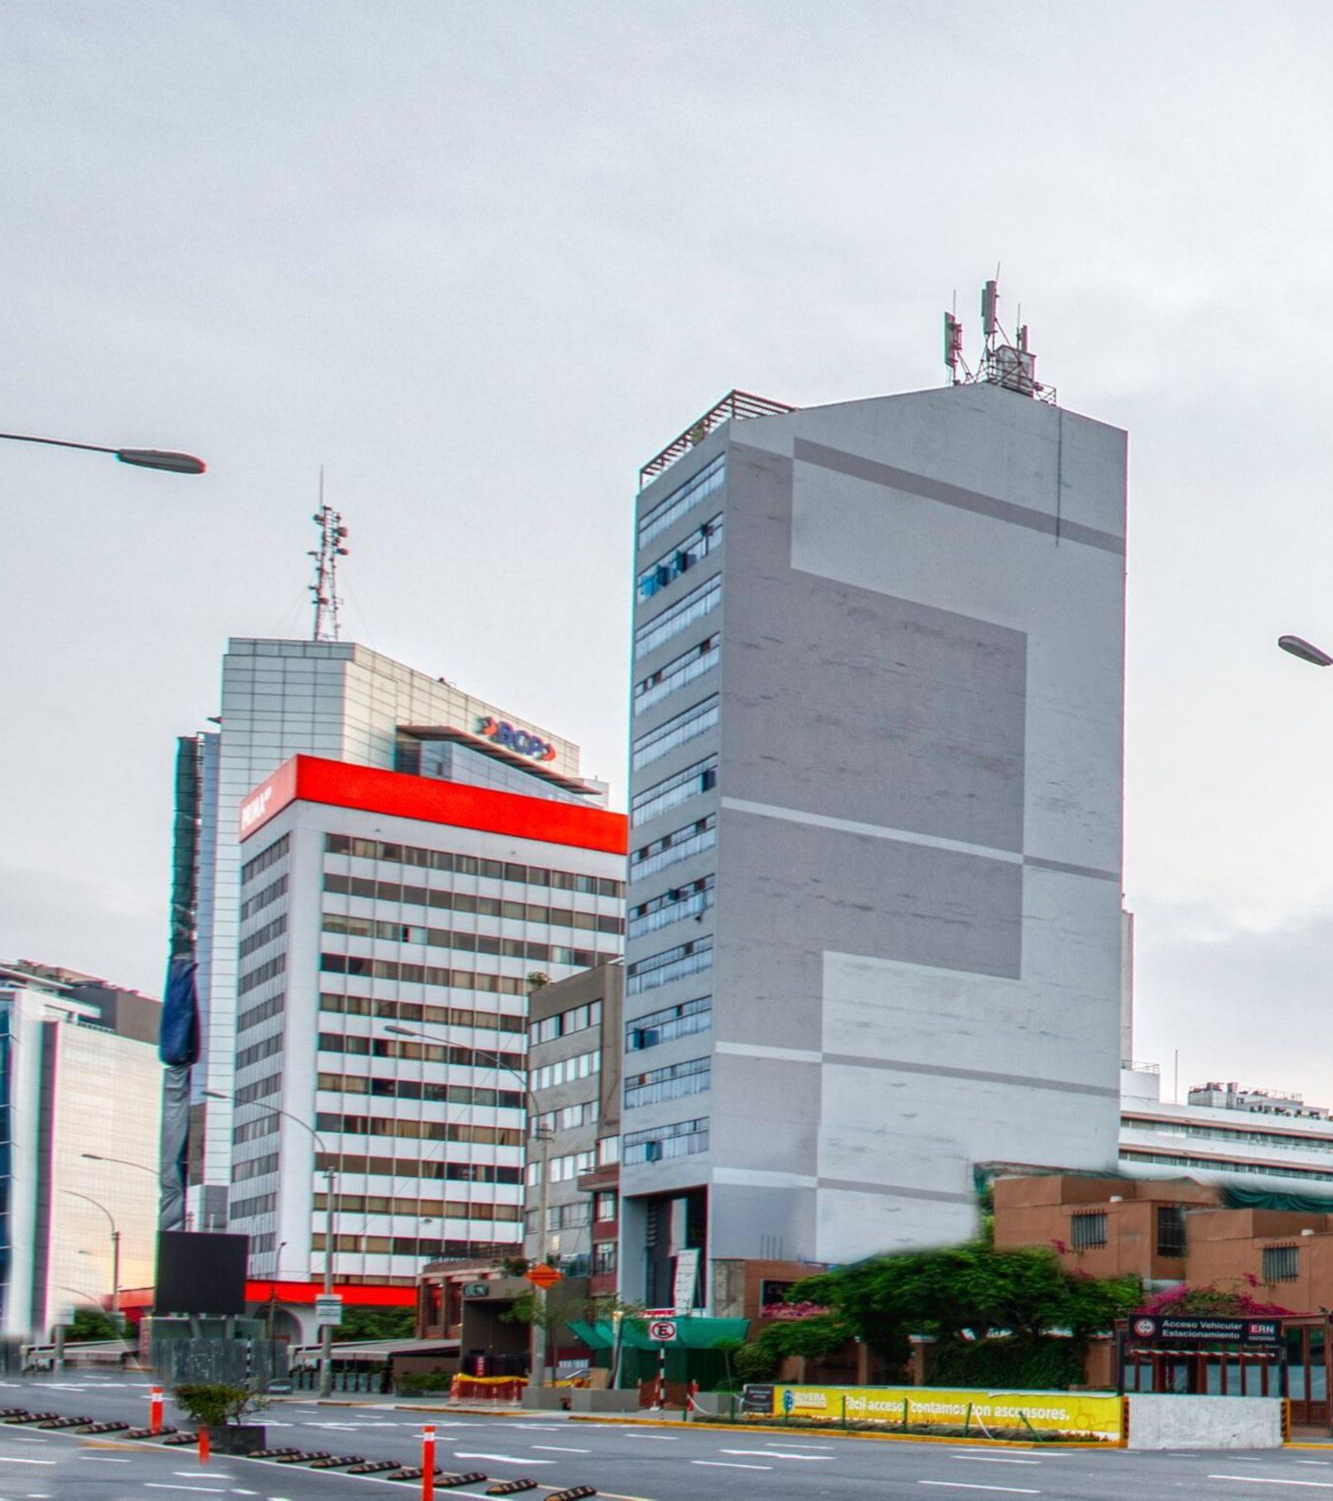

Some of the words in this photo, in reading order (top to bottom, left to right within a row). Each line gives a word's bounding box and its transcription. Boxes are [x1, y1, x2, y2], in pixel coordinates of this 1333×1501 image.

[1162, 1320, 1198, 1329] Acceso
[1200, 1321, 1244, 1331] Vehicular
[1251, 1324, 1275, 1335] ERN
[1162, 1329, 1241, 1339] Estacionamiento
[911, 1402, 965, 1416] contamos
